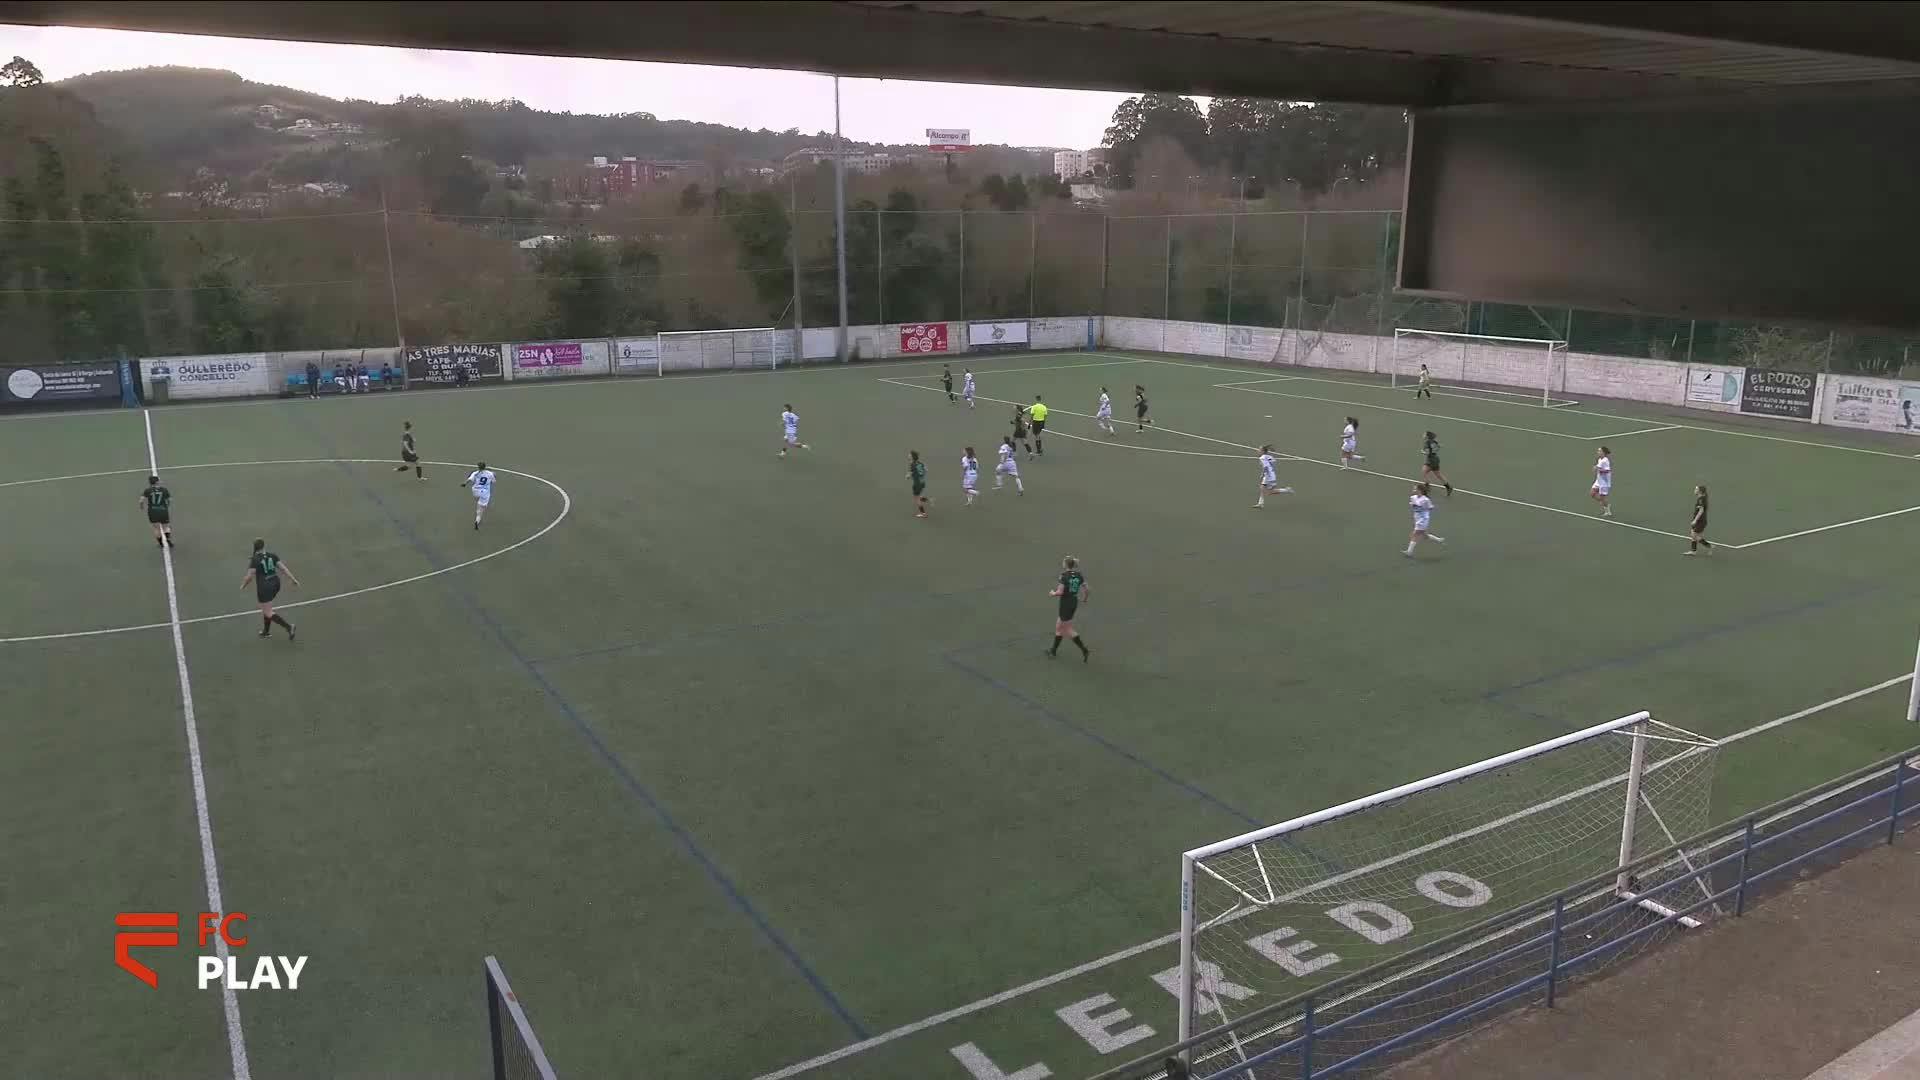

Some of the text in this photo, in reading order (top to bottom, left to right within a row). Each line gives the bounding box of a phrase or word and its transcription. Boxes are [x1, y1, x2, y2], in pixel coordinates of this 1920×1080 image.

[408, 350, 422, 363] AS
[424, 345, 450, 358] TRES
[519, 350, 538, 359] 25N
[457, 356, 478, 364] BAR
[179, 373, 236, 382] CONCELLO
[1750, 372, 1811, 389] EL POTRO
[478, 476, 488, 486] 9
[150, 491, 163, 505] 17
